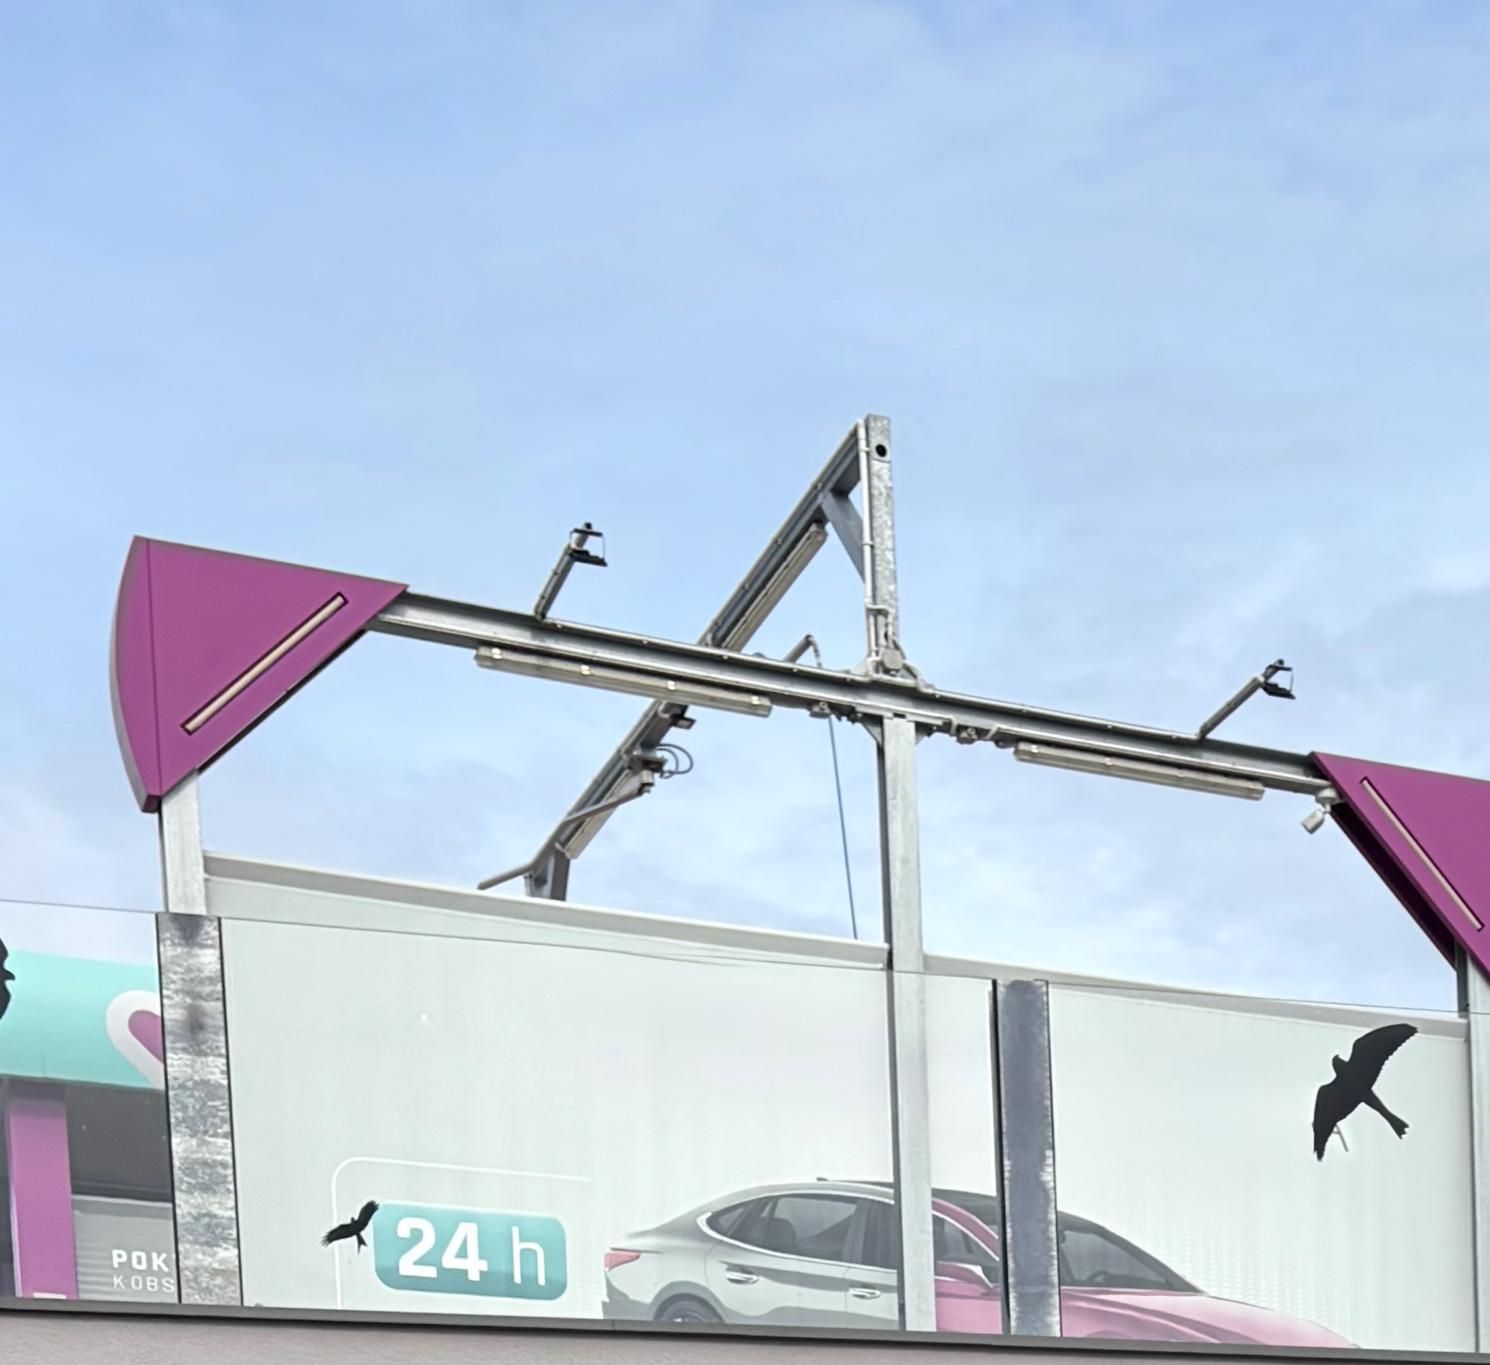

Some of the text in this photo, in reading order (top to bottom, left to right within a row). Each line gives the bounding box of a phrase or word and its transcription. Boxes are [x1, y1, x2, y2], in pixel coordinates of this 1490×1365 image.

[111, 1249, 168, 1272] POK
[397, 1217, 546, 1286] 24 h
[112, 1274, 175, 1293] KOBS
